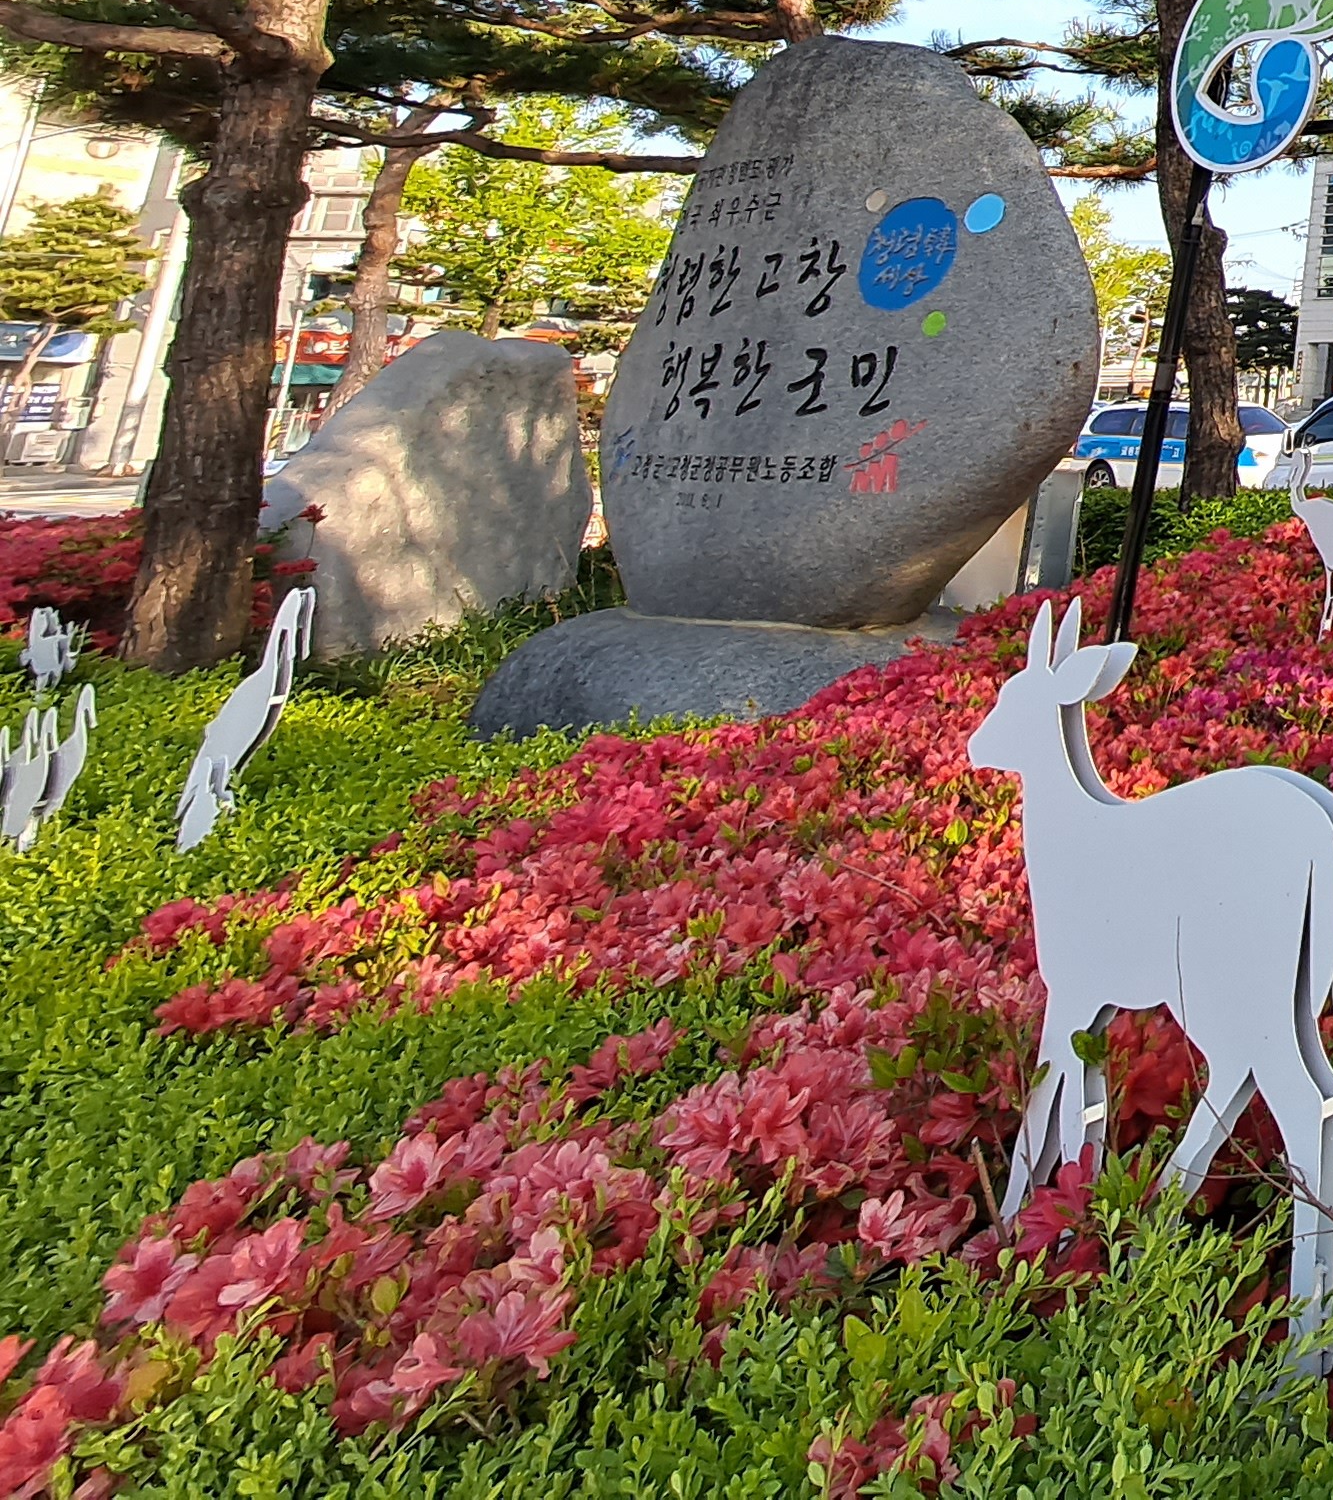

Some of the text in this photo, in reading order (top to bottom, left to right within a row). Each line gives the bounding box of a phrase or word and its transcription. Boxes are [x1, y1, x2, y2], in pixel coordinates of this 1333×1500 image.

[756, 237, 848, 318] 고창
[661, 337, 899, 421] 행복한 군민
